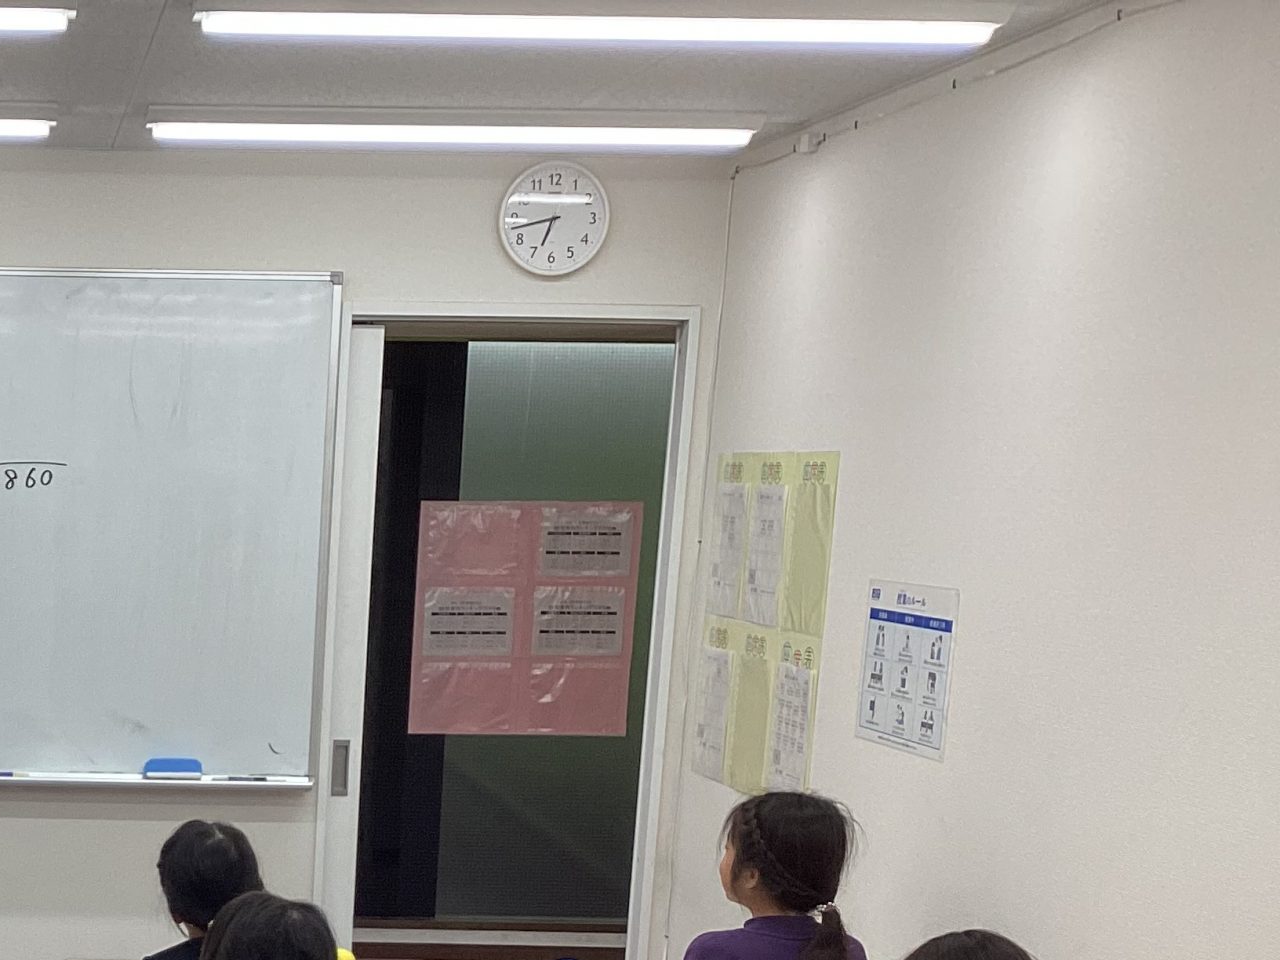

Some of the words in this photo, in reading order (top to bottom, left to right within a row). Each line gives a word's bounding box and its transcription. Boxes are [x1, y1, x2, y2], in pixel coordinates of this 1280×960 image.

[530, 179, 542, 191] 11
[548, 173, 562, 186] 12
[572, 179, 578, 191] 1
[589, 212, 597, 224] 3
[515, 233, 524, 245] 8
[580, 233, 589, 245] 4
[530, 246, 538, 259] 7
[547, 251, 555, 264] 6
[566, 246, 574, 259] 5
